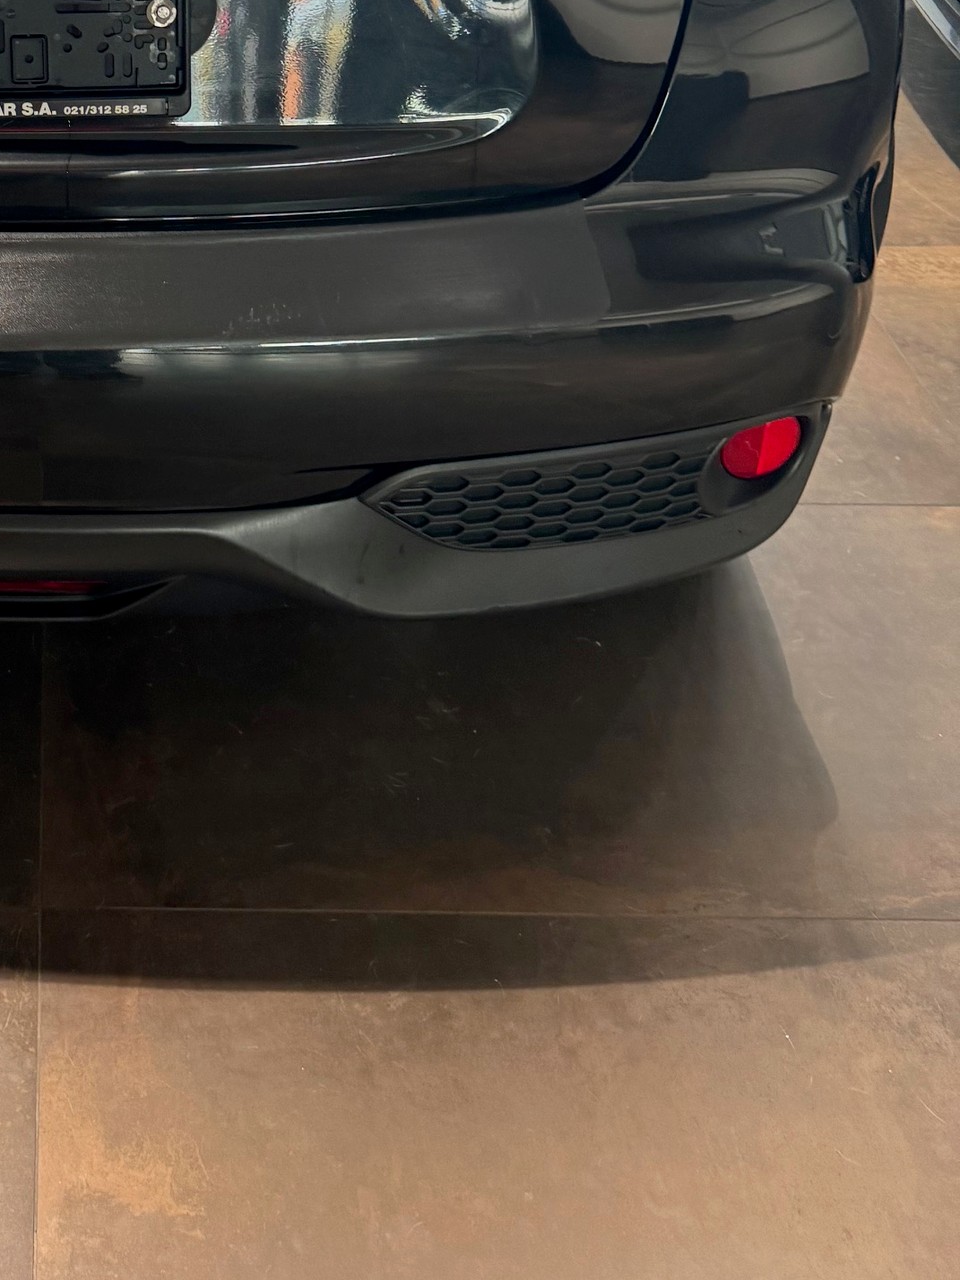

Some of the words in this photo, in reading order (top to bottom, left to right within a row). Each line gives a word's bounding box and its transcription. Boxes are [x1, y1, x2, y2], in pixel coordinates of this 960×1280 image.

[21, 102, 57, 116] S.A.
[63, 105, 112, 115] 021/312
[114, 105, 130, 114] 58
[132, 105, 148, 114] 25
